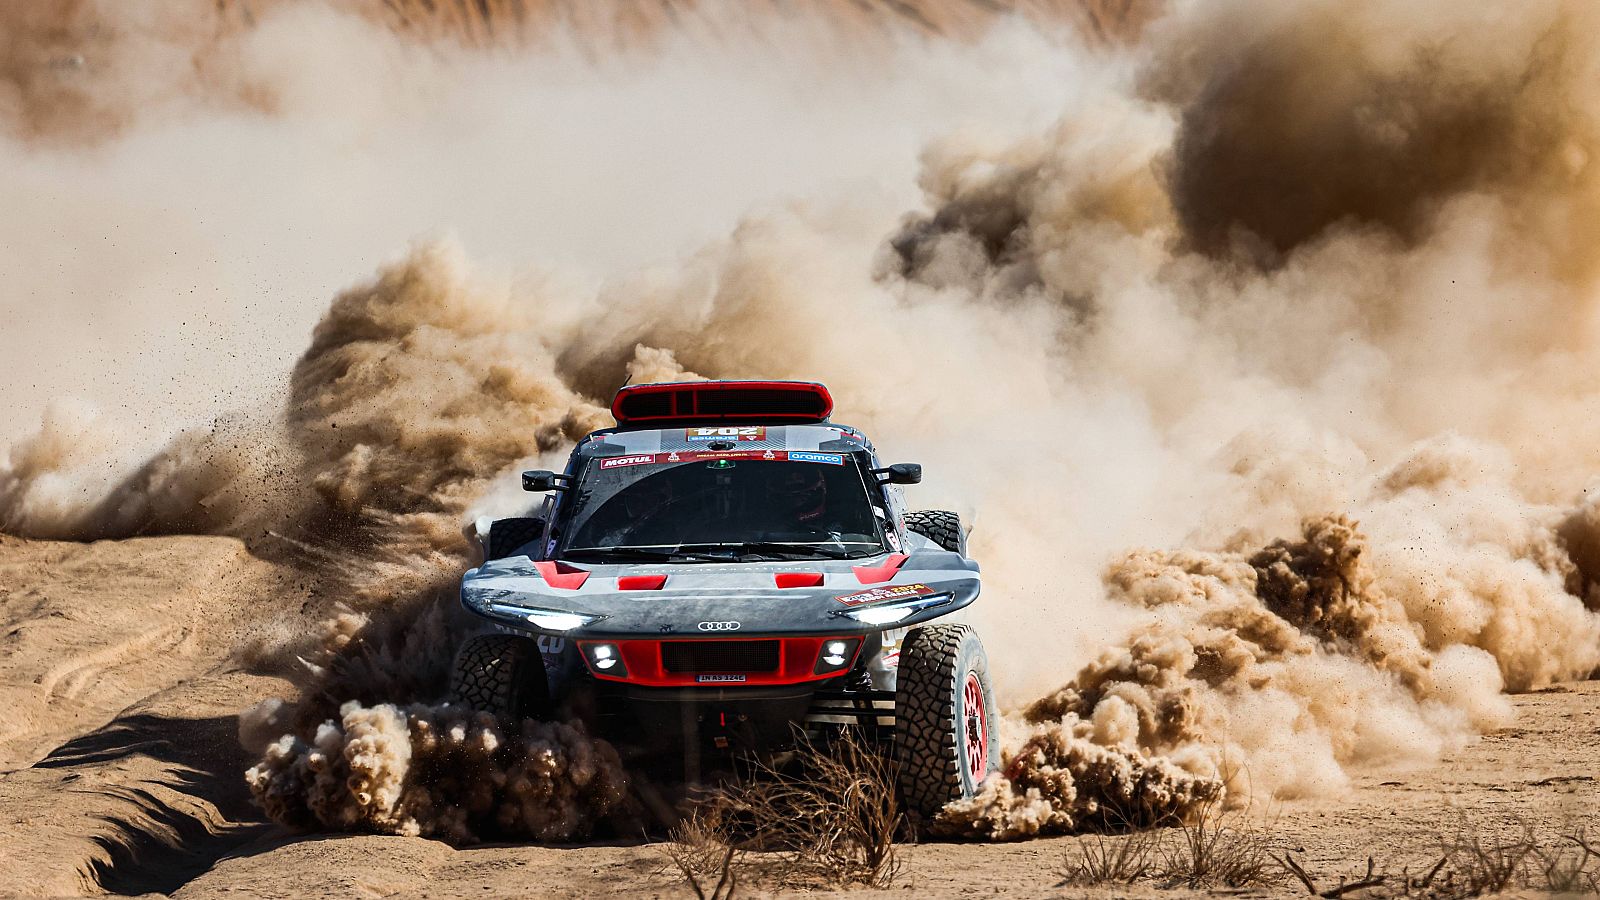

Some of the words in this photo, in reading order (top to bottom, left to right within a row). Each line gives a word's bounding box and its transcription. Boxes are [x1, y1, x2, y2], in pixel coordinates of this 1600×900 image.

[693, 427, 758, 436] 204
[604, 456, 652, 466] MOTUL
[791, 453, 839, 462] aramco
[890, 584, 925, 593] 2024
